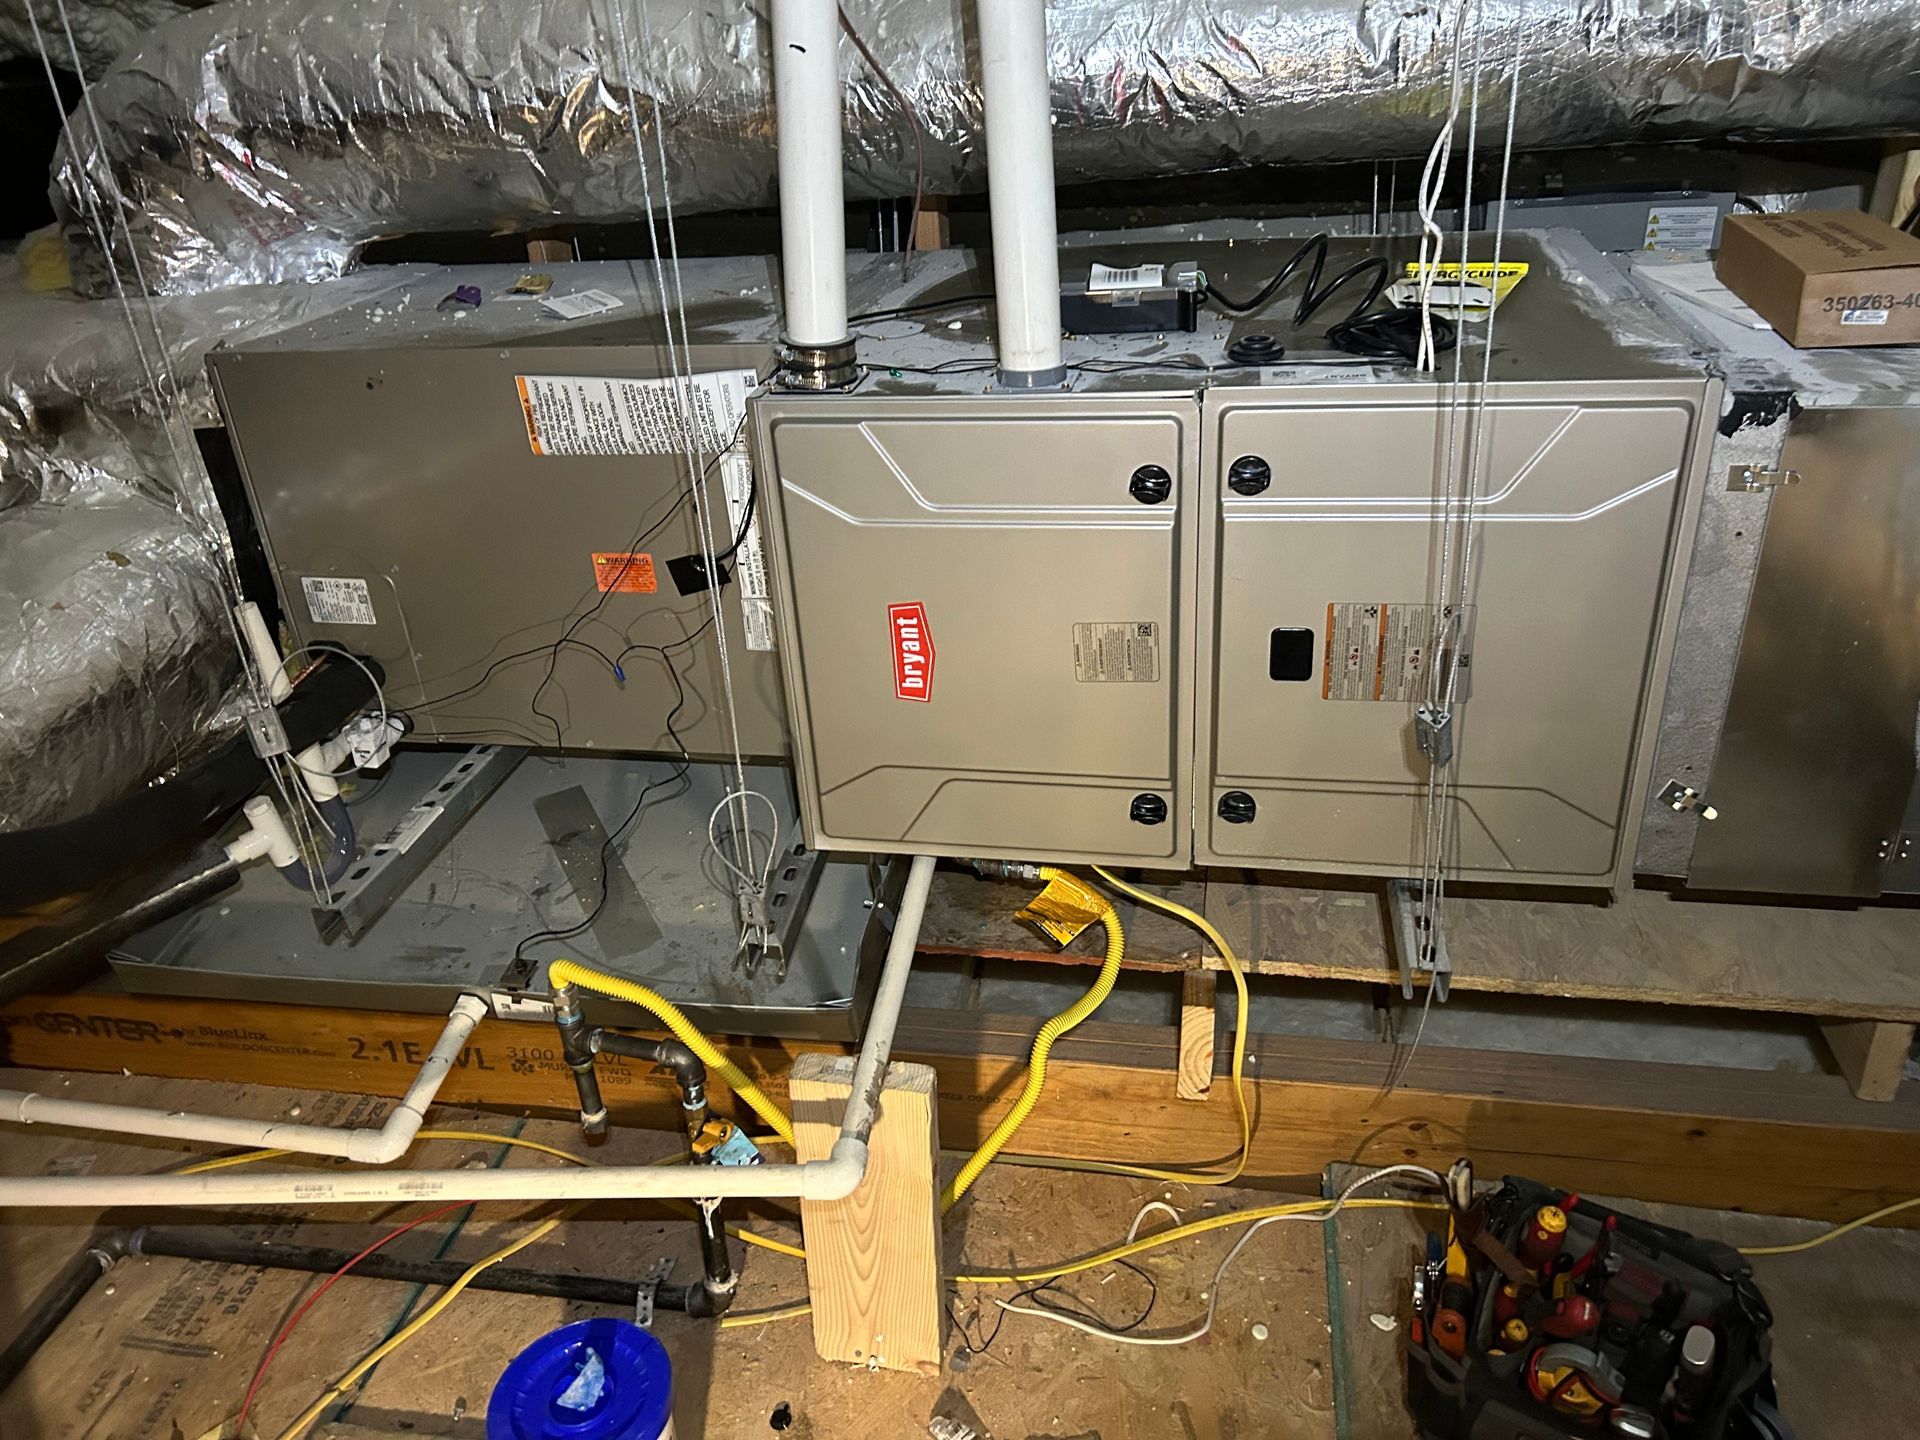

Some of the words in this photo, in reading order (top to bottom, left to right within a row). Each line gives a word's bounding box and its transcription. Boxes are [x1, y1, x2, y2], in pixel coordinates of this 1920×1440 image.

[897, 617, 925, 688] bryant
[34, 1012, 163, 1044] CENTER
[199, 1026, 269, 1042] BlueLinx
[347, 1037, 422, 1065] 2.1E
[453, 1047, 496, 1071] VL
[506, 1046, 555, 1061] 3100
[600, 1075, 632, 1085] 1089
